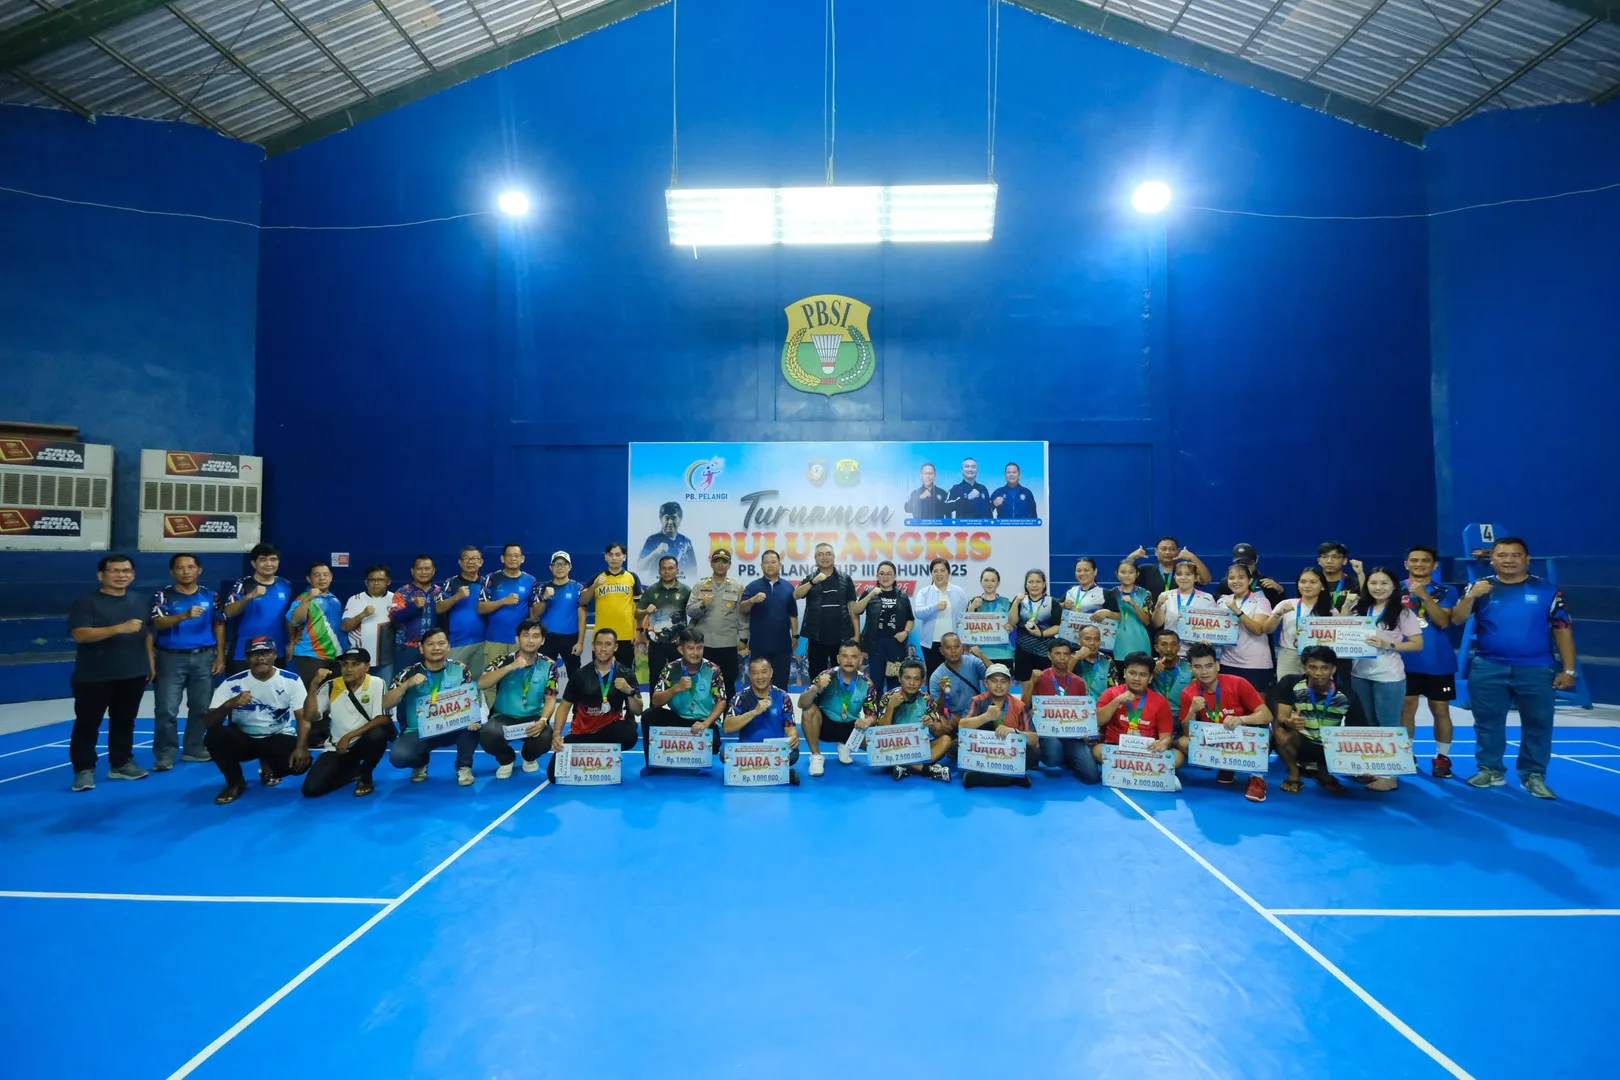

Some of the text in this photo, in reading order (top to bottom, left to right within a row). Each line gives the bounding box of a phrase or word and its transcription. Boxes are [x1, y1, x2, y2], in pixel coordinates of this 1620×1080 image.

[801, 300, 852, 329] PBSI
[740, 490, 895, 530] Turnamen
[1483, 526, 1492, 541] 4
[708, 532, 992, 561] BULUTANGKIS
[738, 564, 760, 576] PB.
[862, 564, 874, 576] III
[598, 584, 630, 597] MALINAU
[964, 622, 1000, 631] JUARA 1
[1186, 617, 1220, 628] JUARA
[1224, 620, 1231, 629] 3
[464, 698, 471, 708] 3
[1042, 709, 1088, 719] JUARA 3
[658, 740, 704, 750] JUARA 3
[876, 735, 920, 748] JUARA 1
[1249, 742, 1256, 752] 1
[1010, 747, 1017, 757] 3
[1336, 742, 1397, 753] JUARA 1
[571, 757, 613, 767] UARA 2
[734, 756, 781, 767] JUARA 3
[1210, 756, 1221, 764] Rp.
[1112, 759, 1166, 773] JUARA 2
[1351, 762, 1362, 770] Rp.
